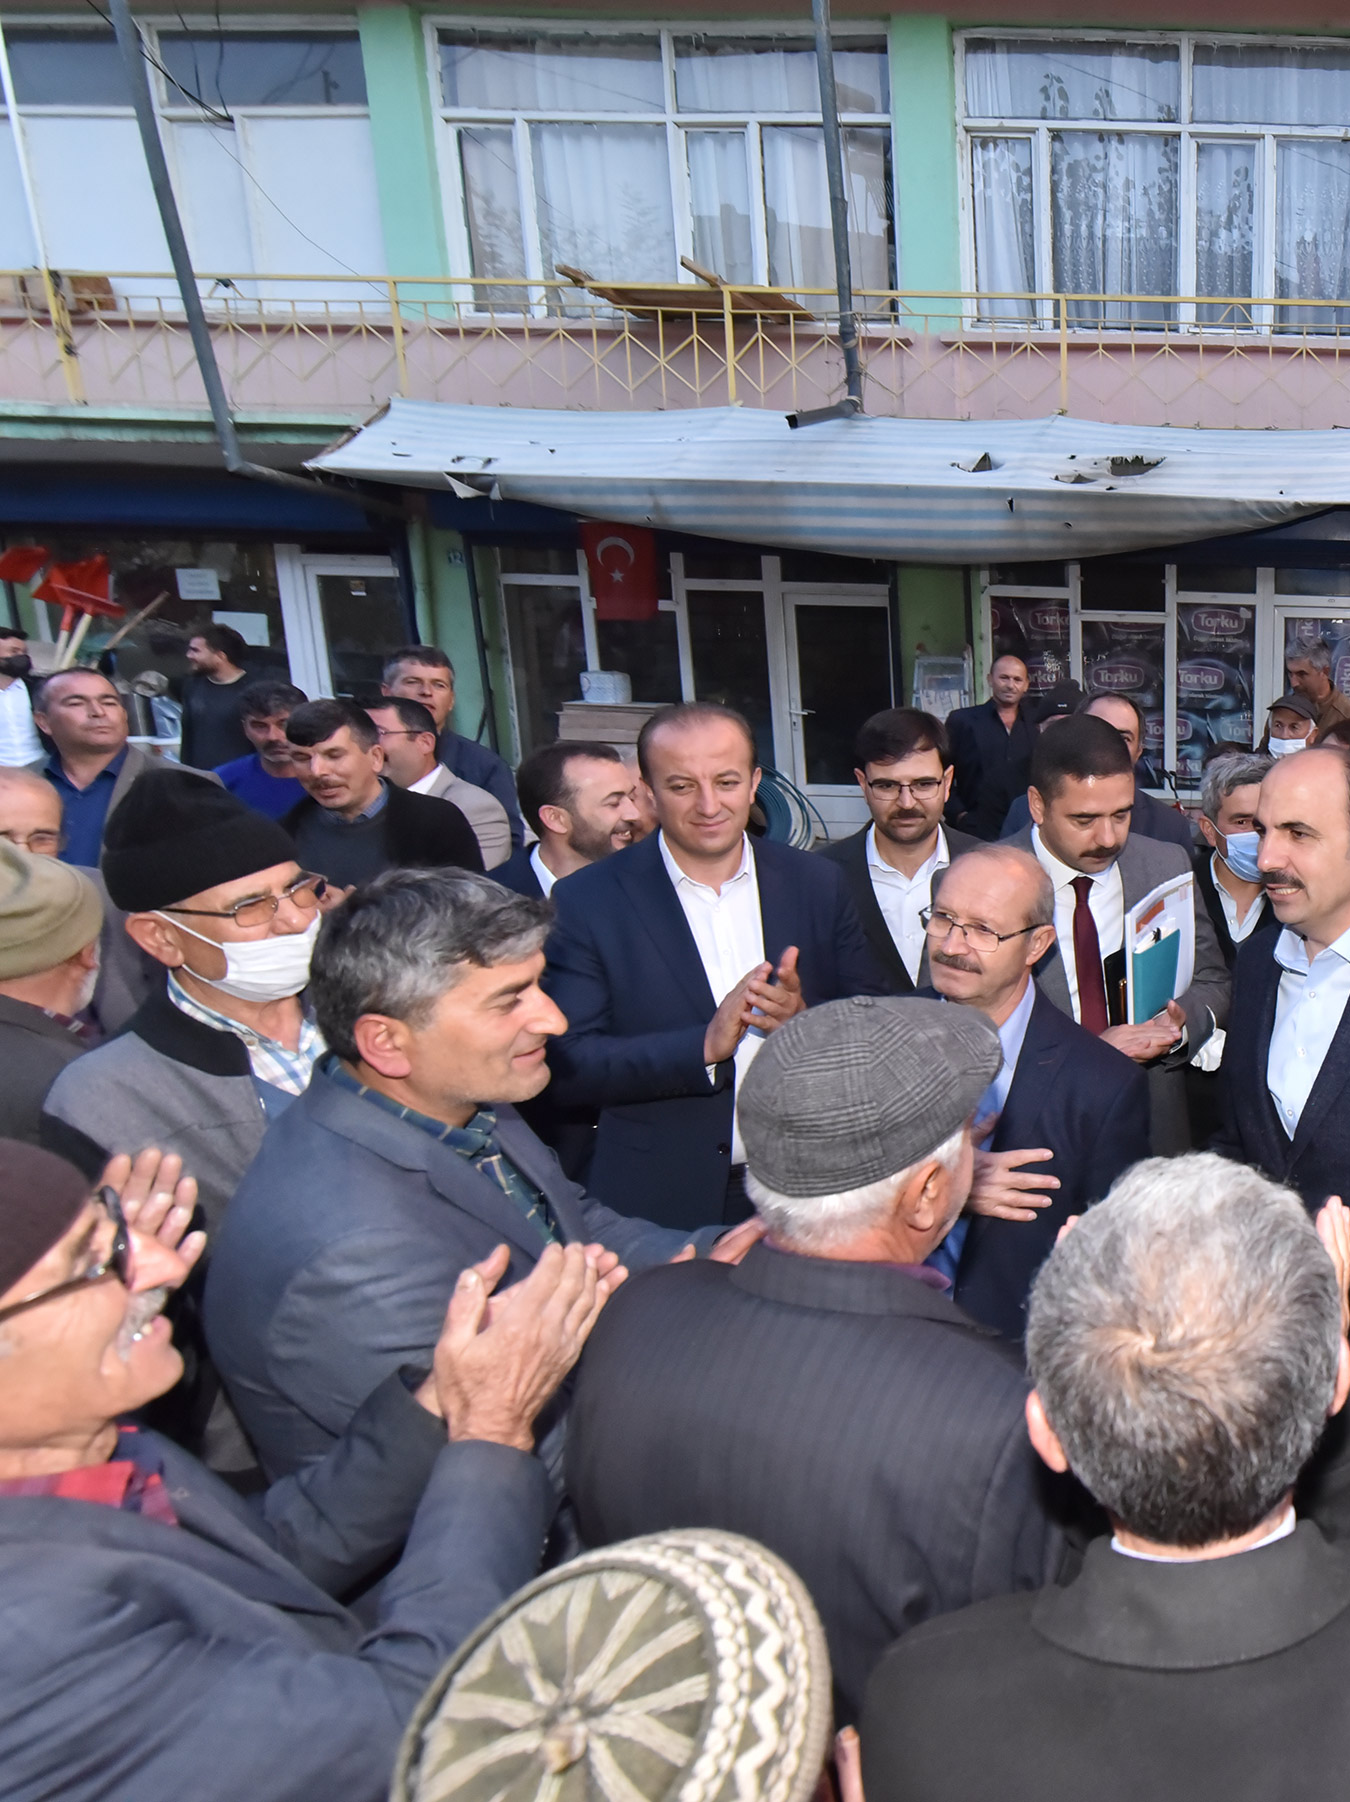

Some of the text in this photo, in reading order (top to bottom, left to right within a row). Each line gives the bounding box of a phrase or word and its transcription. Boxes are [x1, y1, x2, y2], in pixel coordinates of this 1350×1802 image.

[1199, 612, 1239, 629] Torku
[1097, 669, 1138, 684] Torku
[1179, 670, 1218, 685] Torku
